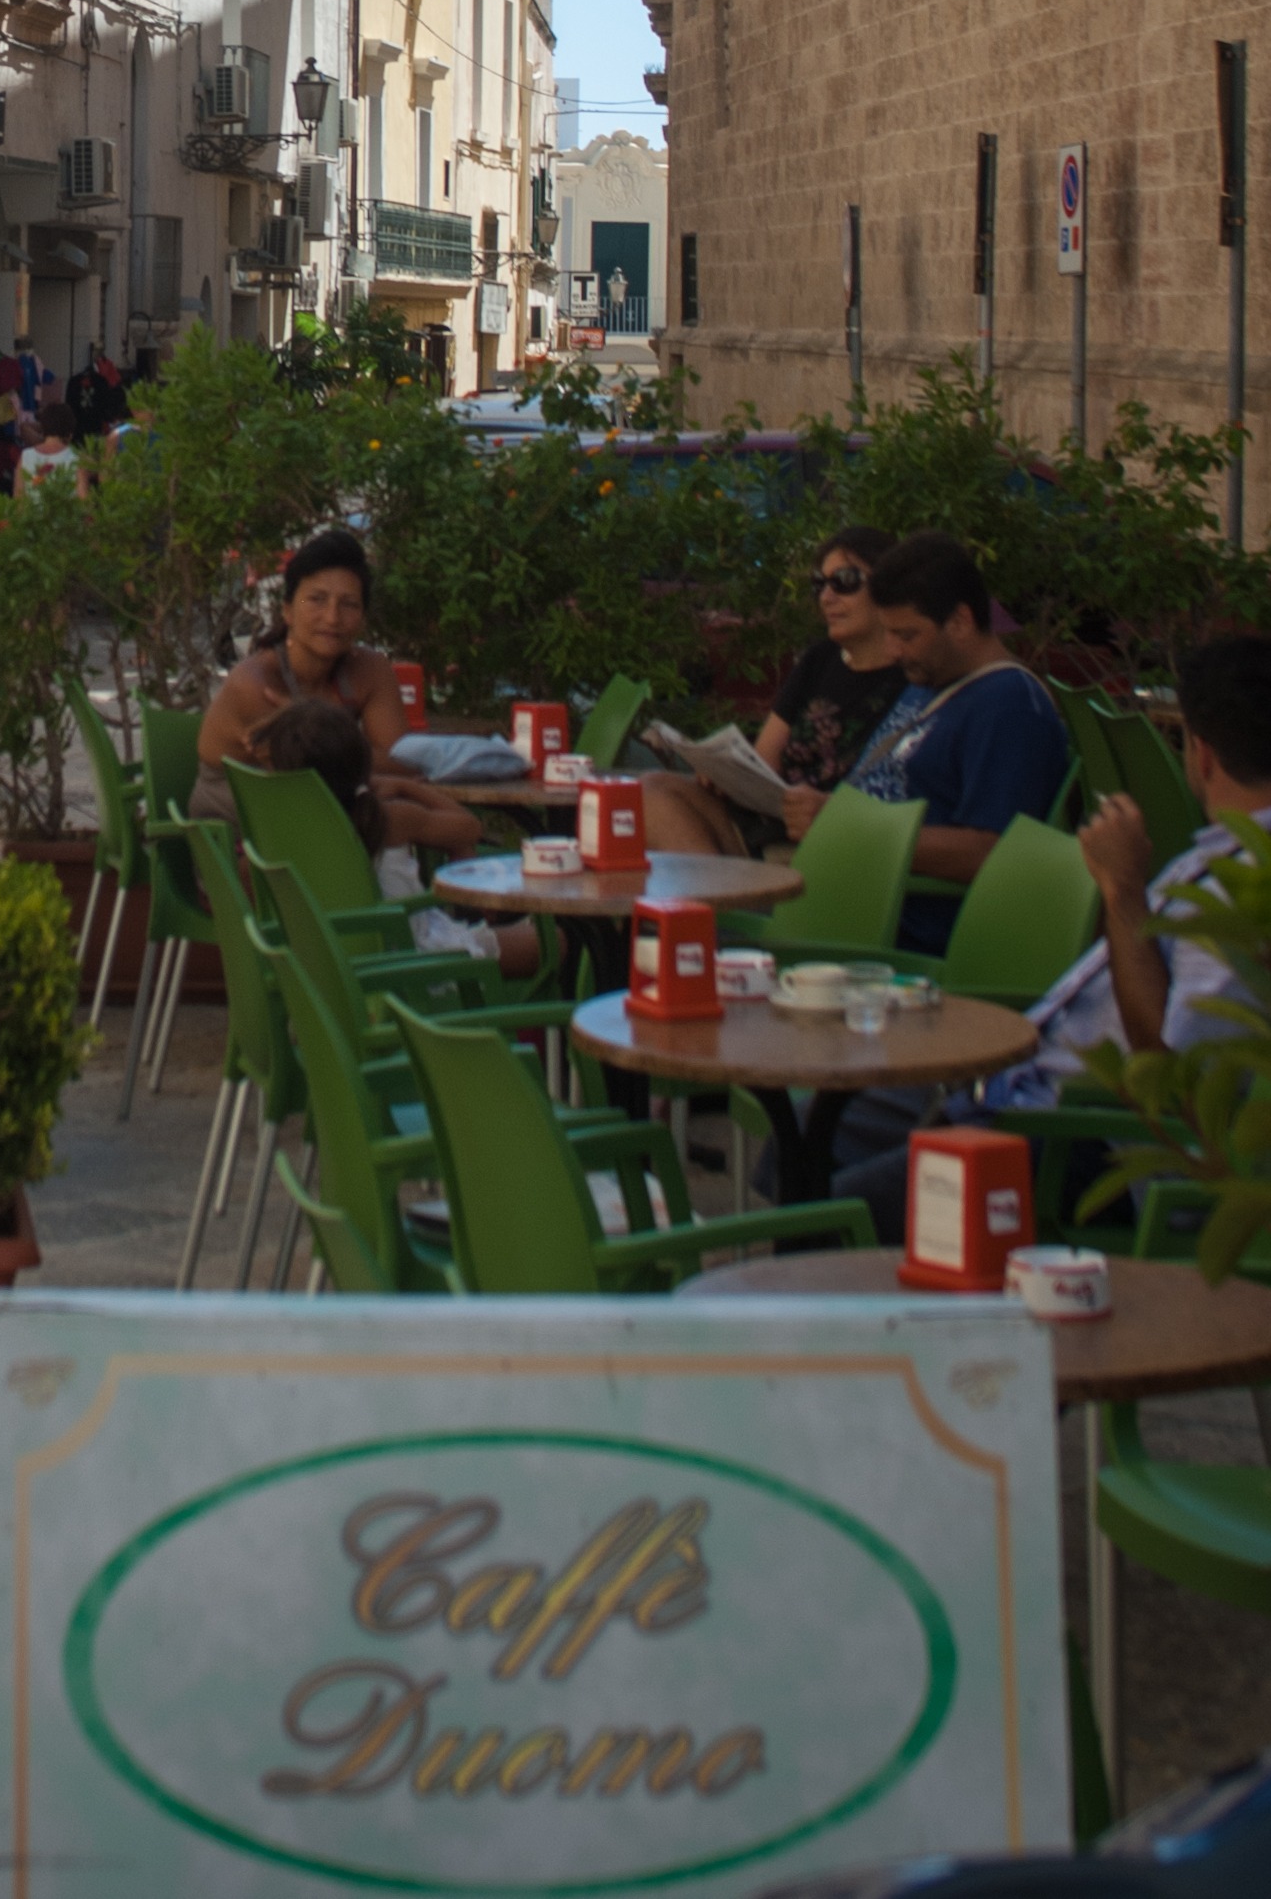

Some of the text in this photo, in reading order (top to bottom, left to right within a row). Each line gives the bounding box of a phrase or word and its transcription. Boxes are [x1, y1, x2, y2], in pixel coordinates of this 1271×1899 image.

[573, 275, 595, 301] T
[342, 1490, 709, 1680] Caffè
[261, 1658, 765, 1798] Duomo
